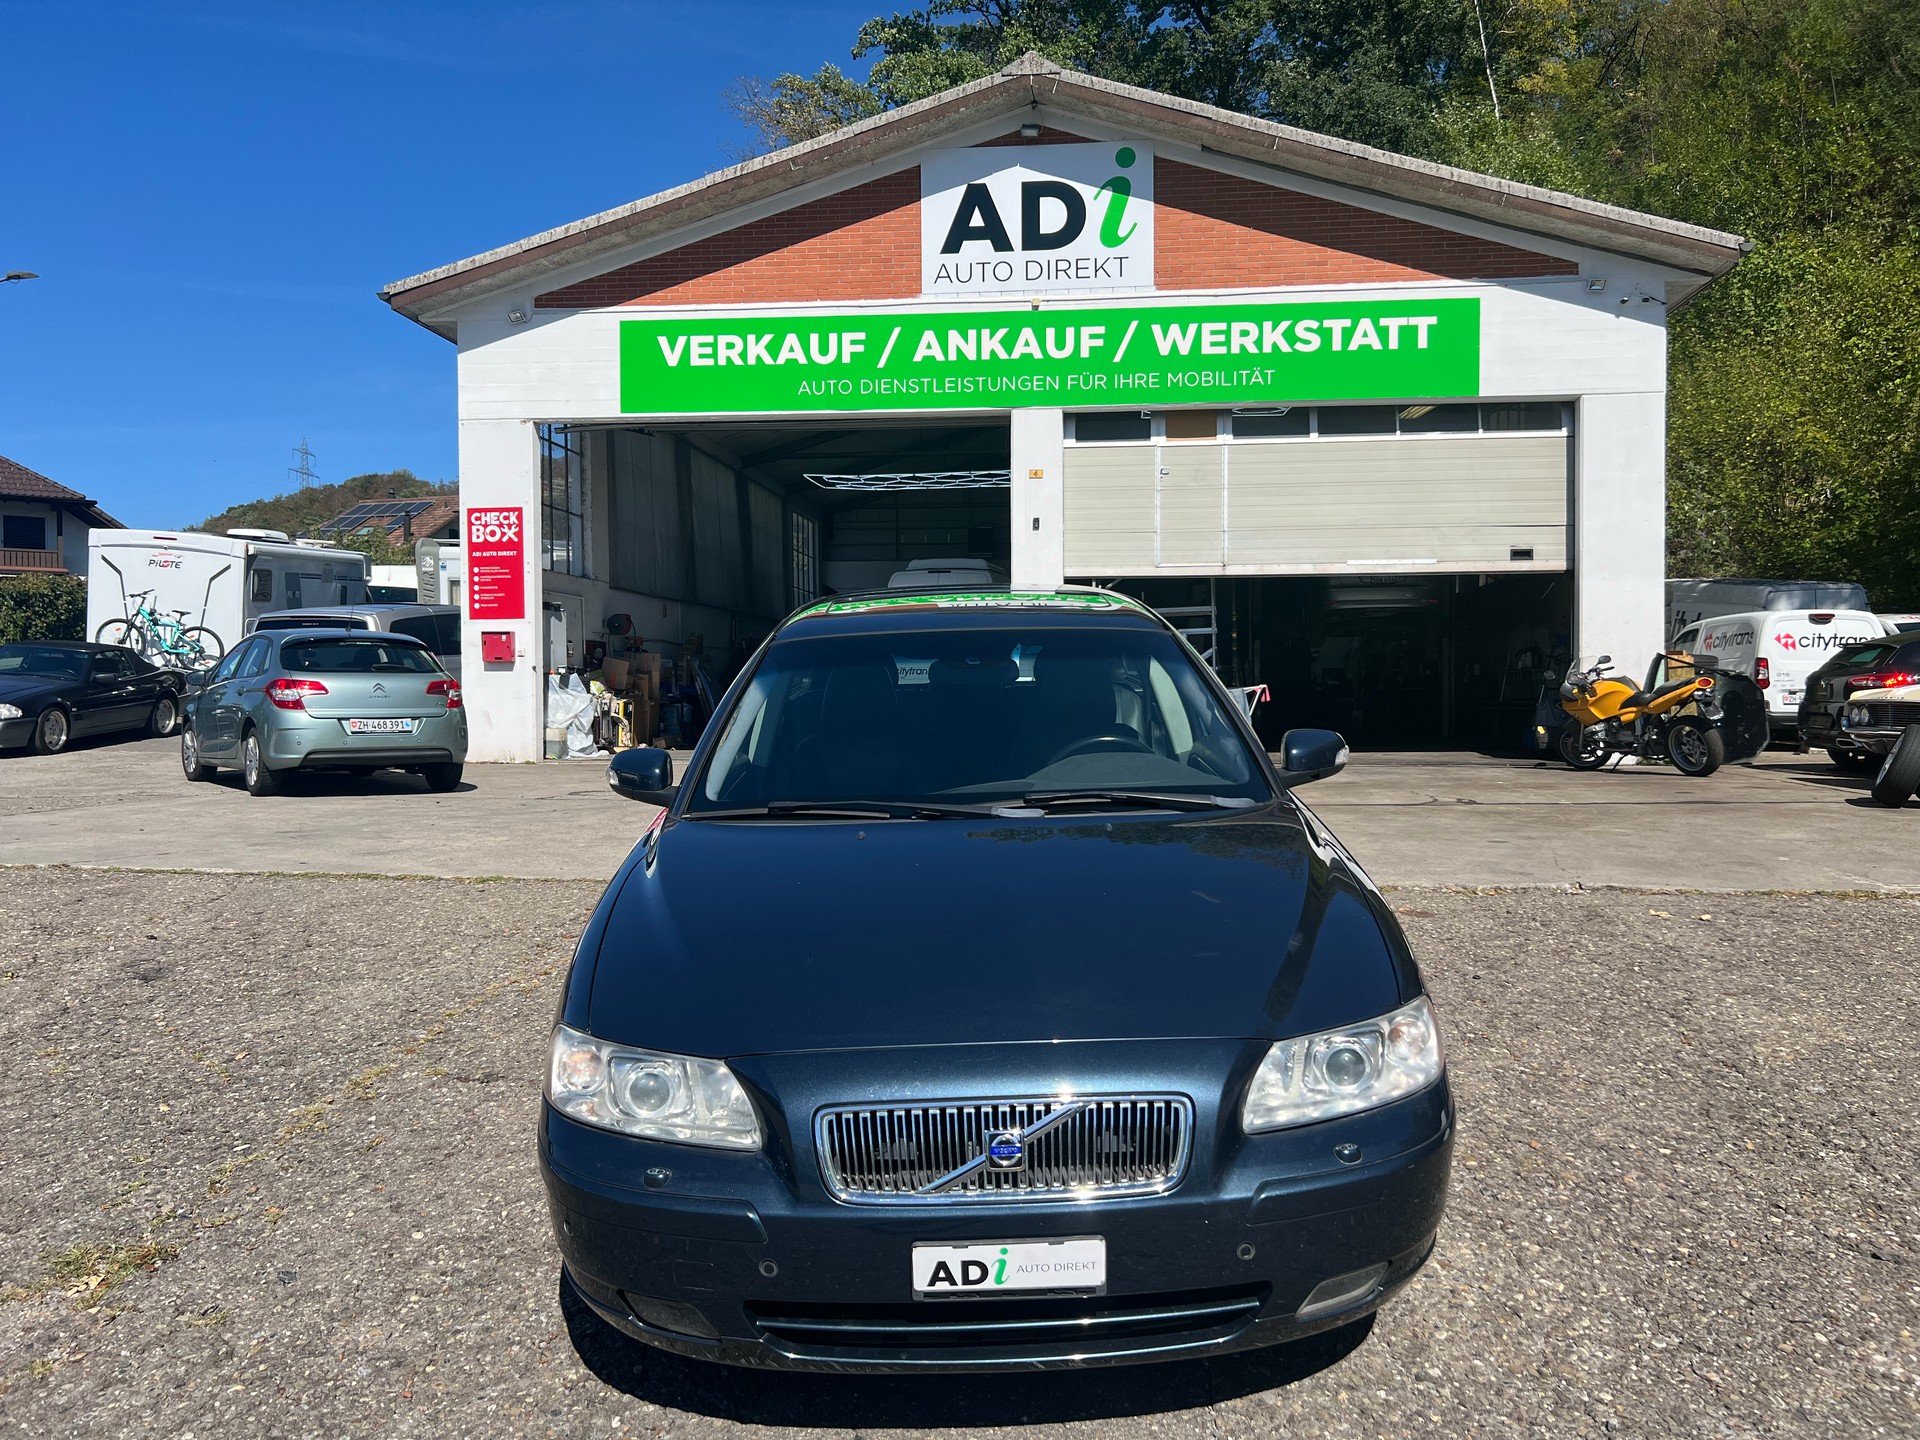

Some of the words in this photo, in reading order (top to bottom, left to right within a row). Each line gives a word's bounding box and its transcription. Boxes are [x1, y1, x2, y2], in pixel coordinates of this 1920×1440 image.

[939, 146, 1138, 255] ADi
[933, 260, 1014, 285] AUTO
[1025, 256, 1130, 281] DIREKT
[656, 331, 867, 367] VERKAUF
[912, 325, 1106, 363] ANKAUF
[1150, 315, 1438, 356] WERKSTATT
[797, 379, 854, 396] AUTO
[859, 373, 1060, 395] DIENSTLEISTUNGEN
[1066, 371, 1107, 391] FÜR
[1114, 372, 1160, 390] IHRE
[1167, 367, 1276, 388] MOBILITÄT
[470, 511, 519, 525] CHECK
[1712, 630, 1755, 651] citytrans
[896, 666, 929, 677] itytran
[926, 1247, 1010, 1287] ADi
[1016, 1263, 1051, 1274] AUTO
[1053, 1261, 1097, 1273] DIREKT
